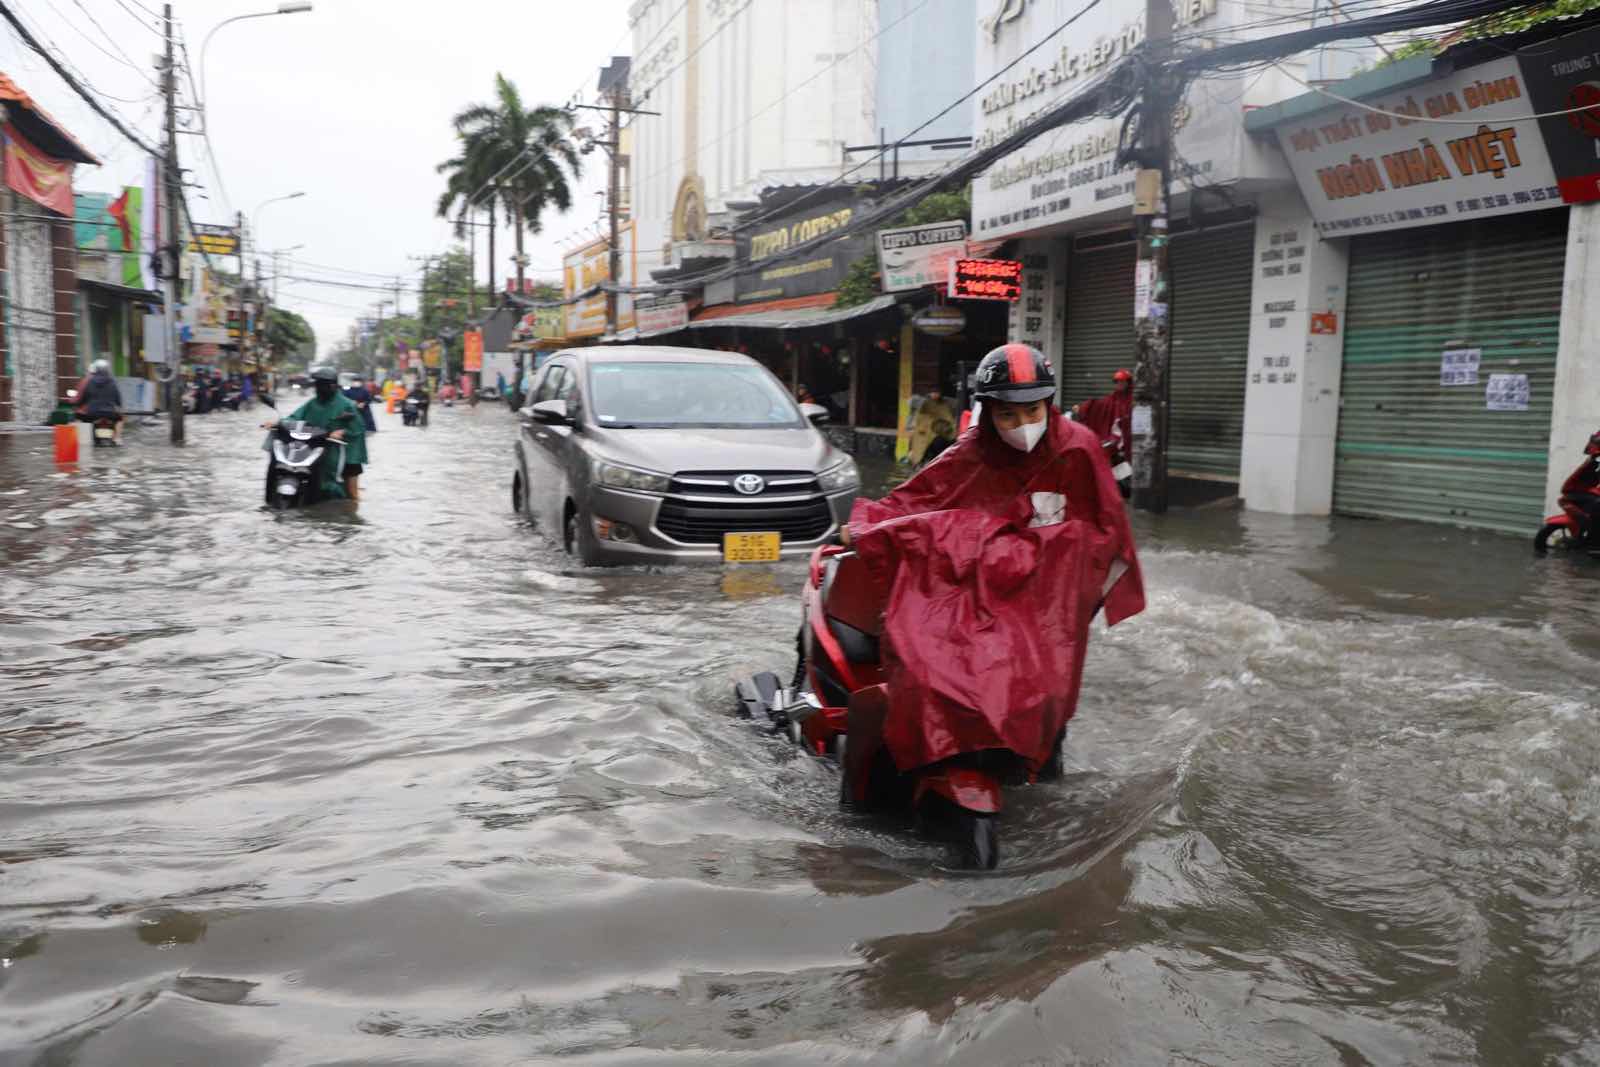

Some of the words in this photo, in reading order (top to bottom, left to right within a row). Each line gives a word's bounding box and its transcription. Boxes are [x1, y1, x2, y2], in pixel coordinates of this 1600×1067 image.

[1316, 153, 1386, 200] NGÔI
[1381, 137, 1452, 189] NHÀ
[1446, 124, 1521, 179] VIỆT
[882, 230, 917, 249] ZIPPO
[918, 225, 963, 246] COFFEE
